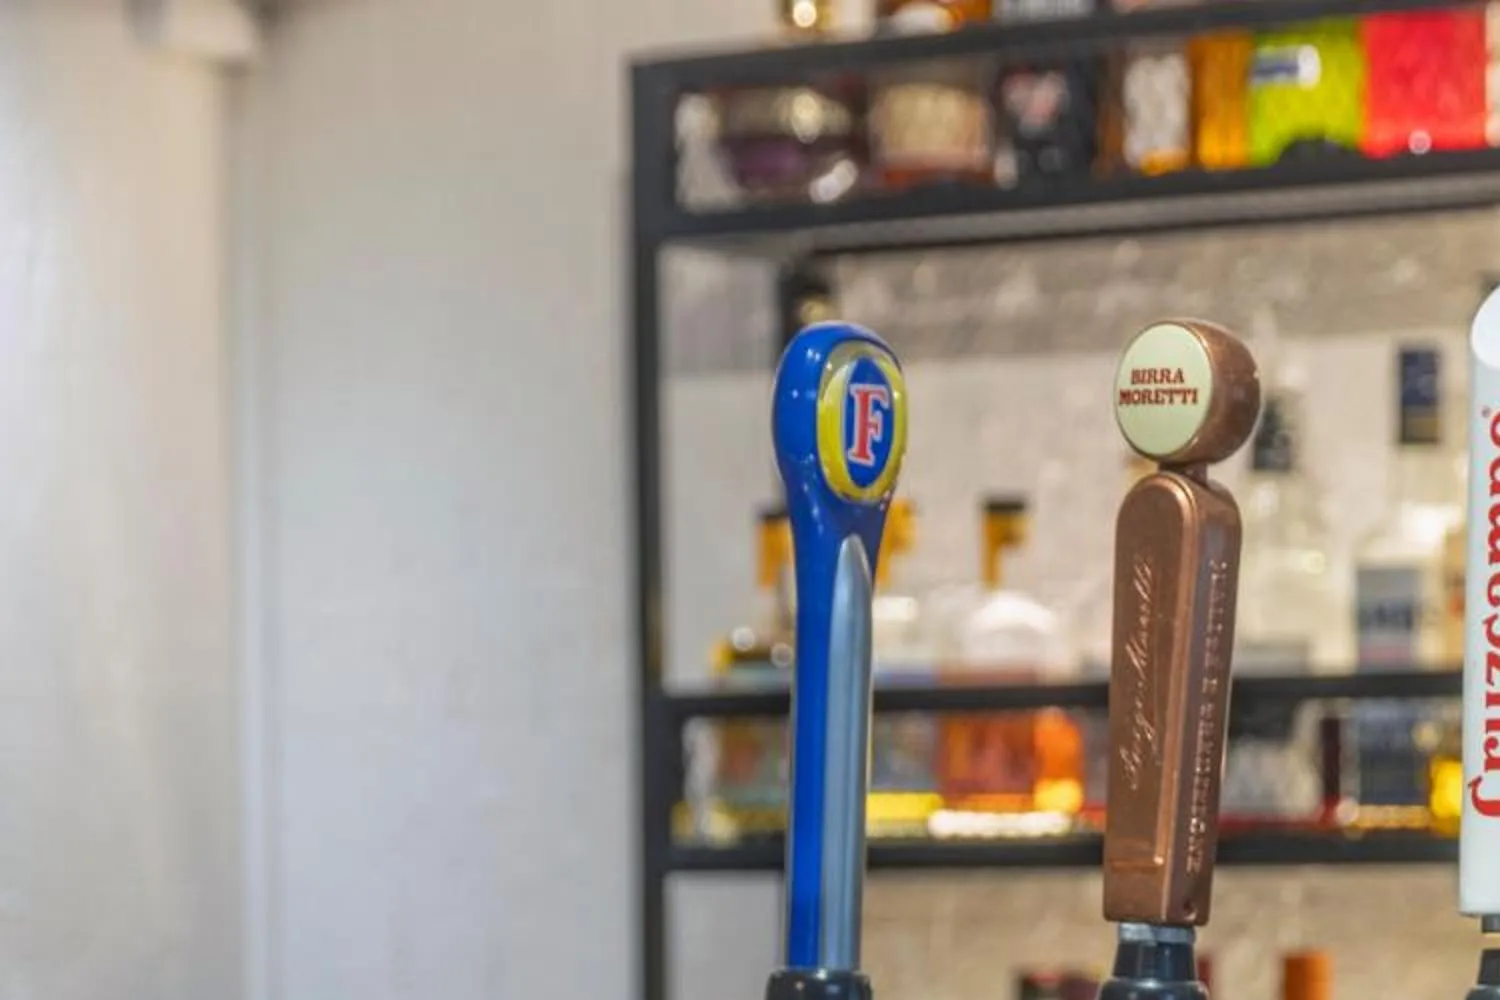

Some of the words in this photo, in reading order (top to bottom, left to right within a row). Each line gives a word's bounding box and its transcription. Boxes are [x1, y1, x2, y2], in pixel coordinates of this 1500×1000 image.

[1131, 368, 1185, 385] BIRRA
[1119, 388, 1198, 405] MORETTI
[848, 383, 889, 467] F
